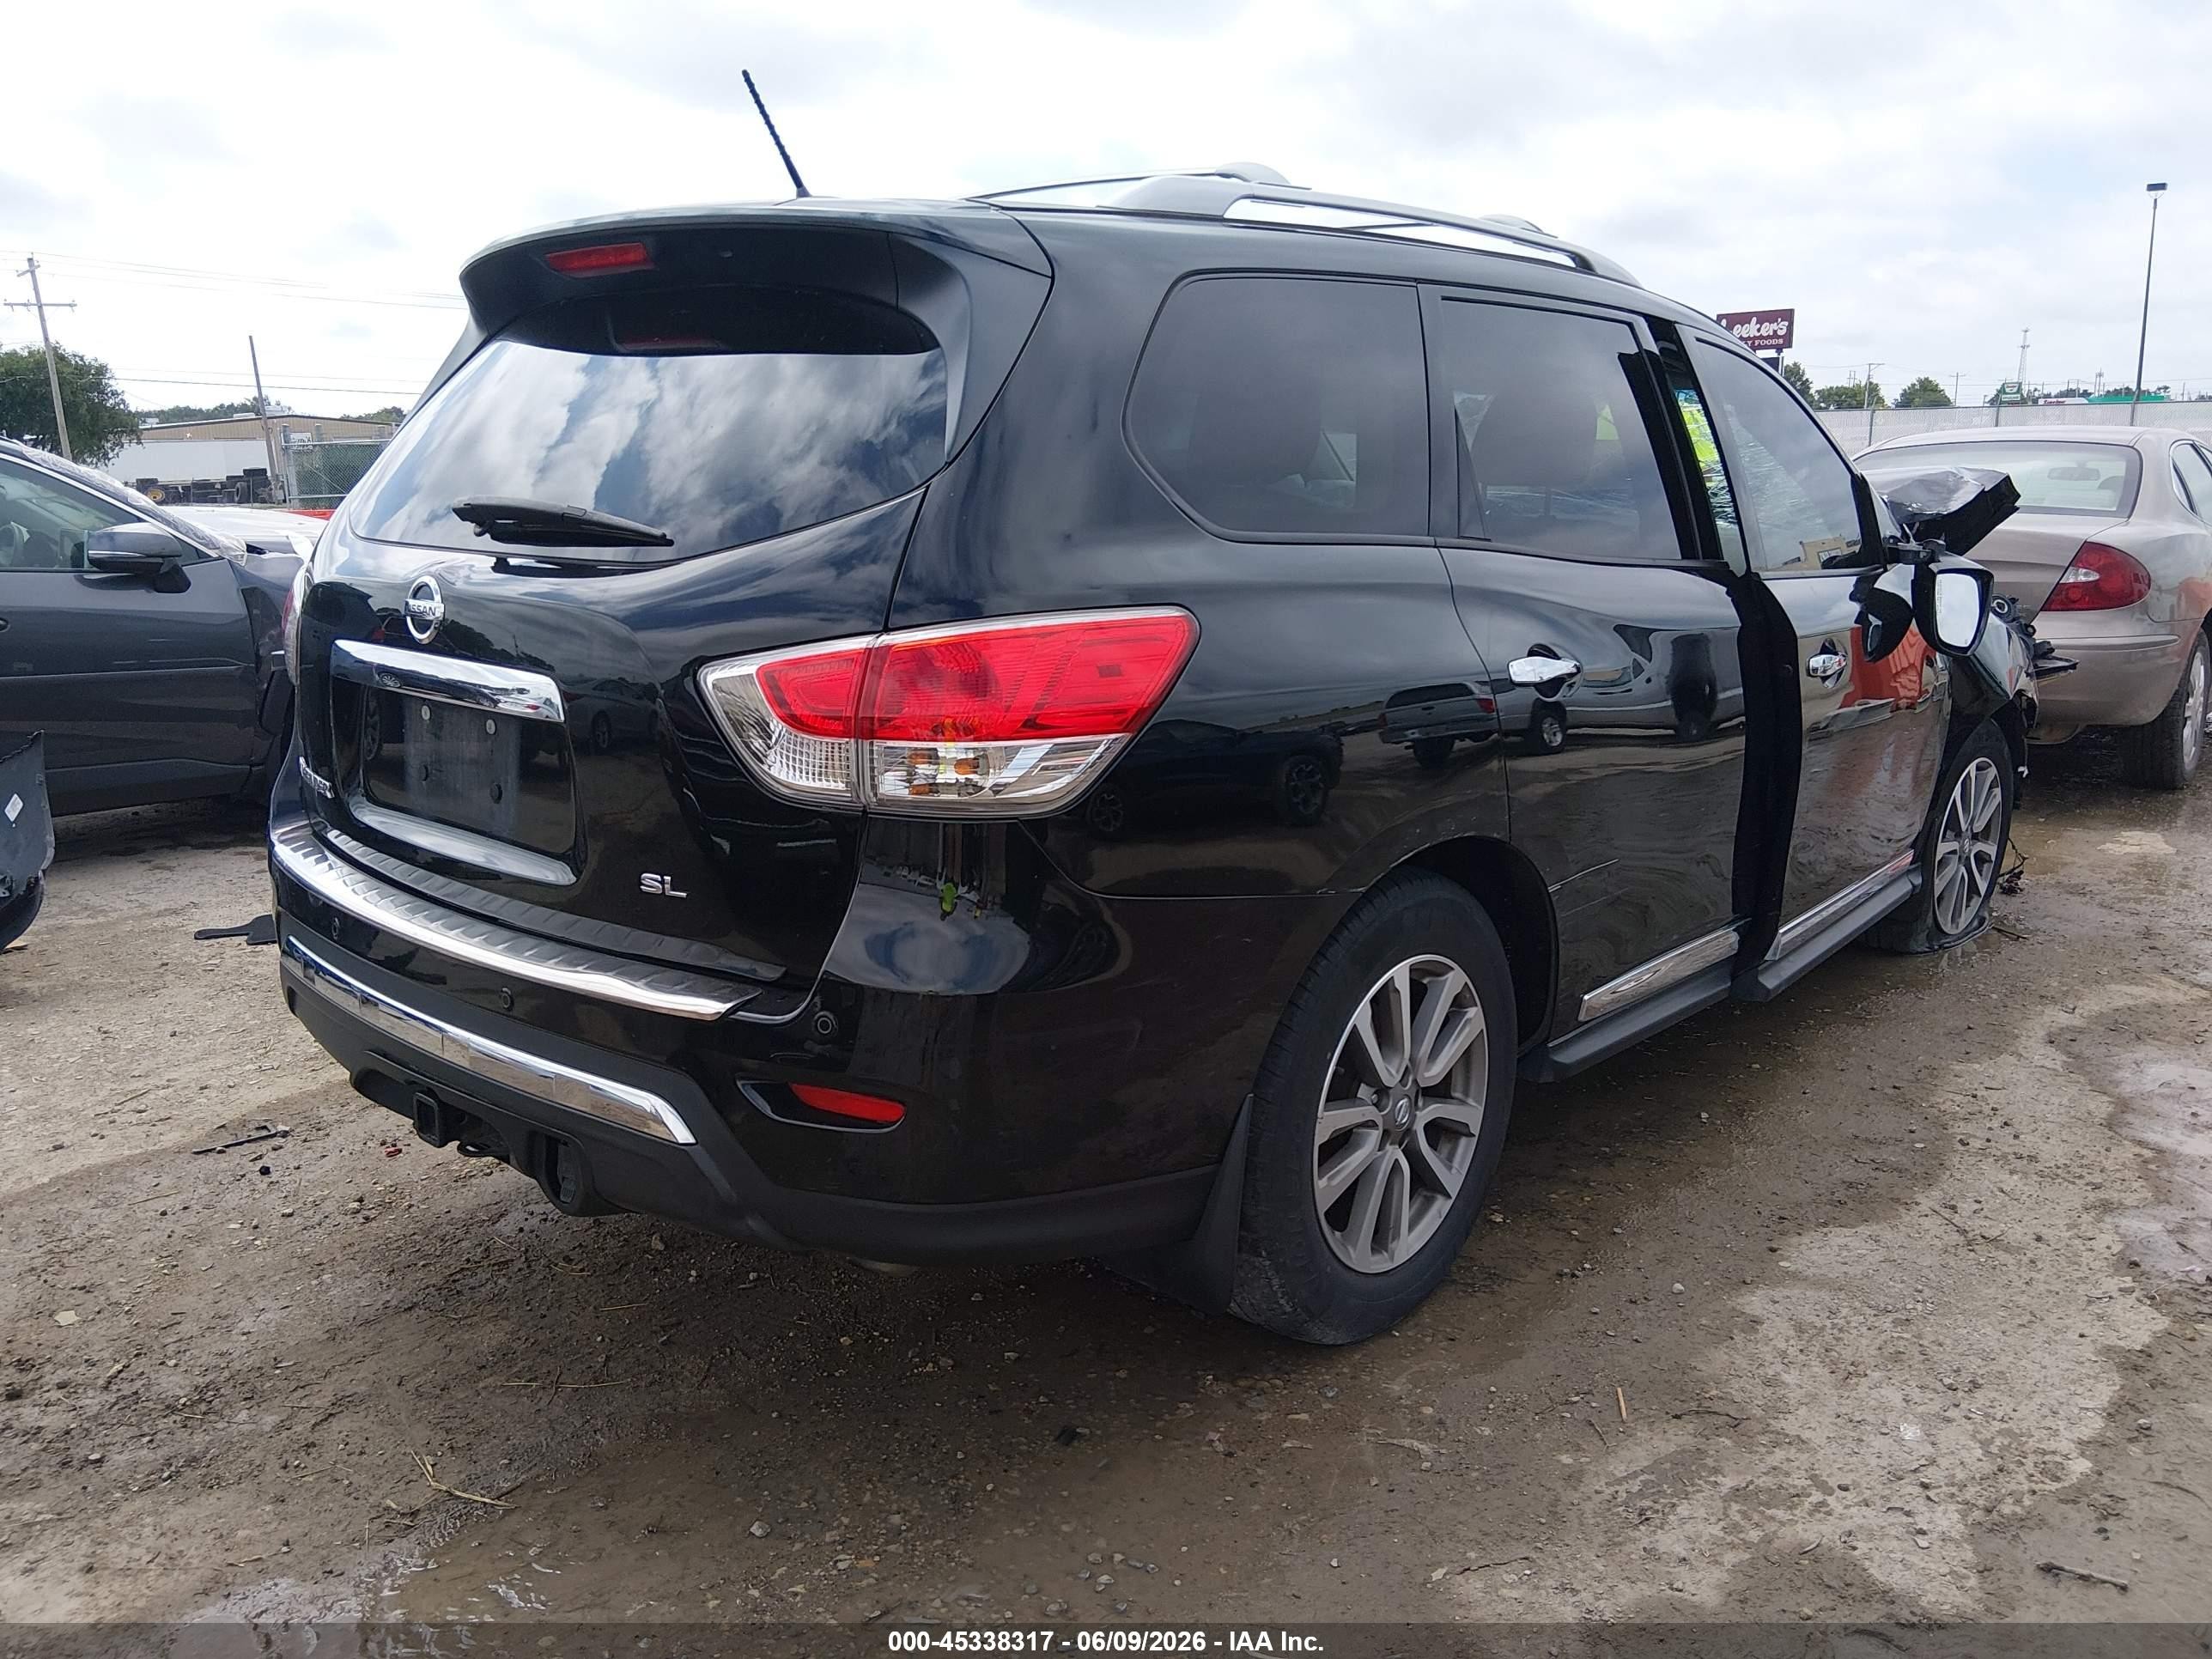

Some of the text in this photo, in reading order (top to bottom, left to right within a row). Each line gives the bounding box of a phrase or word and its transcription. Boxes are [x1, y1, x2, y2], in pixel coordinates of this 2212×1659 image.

[1754, 338, 1784, 347] FOODS
[407, 602, 436, 617] ISSAN
[640, 872, 688, 898] SL
